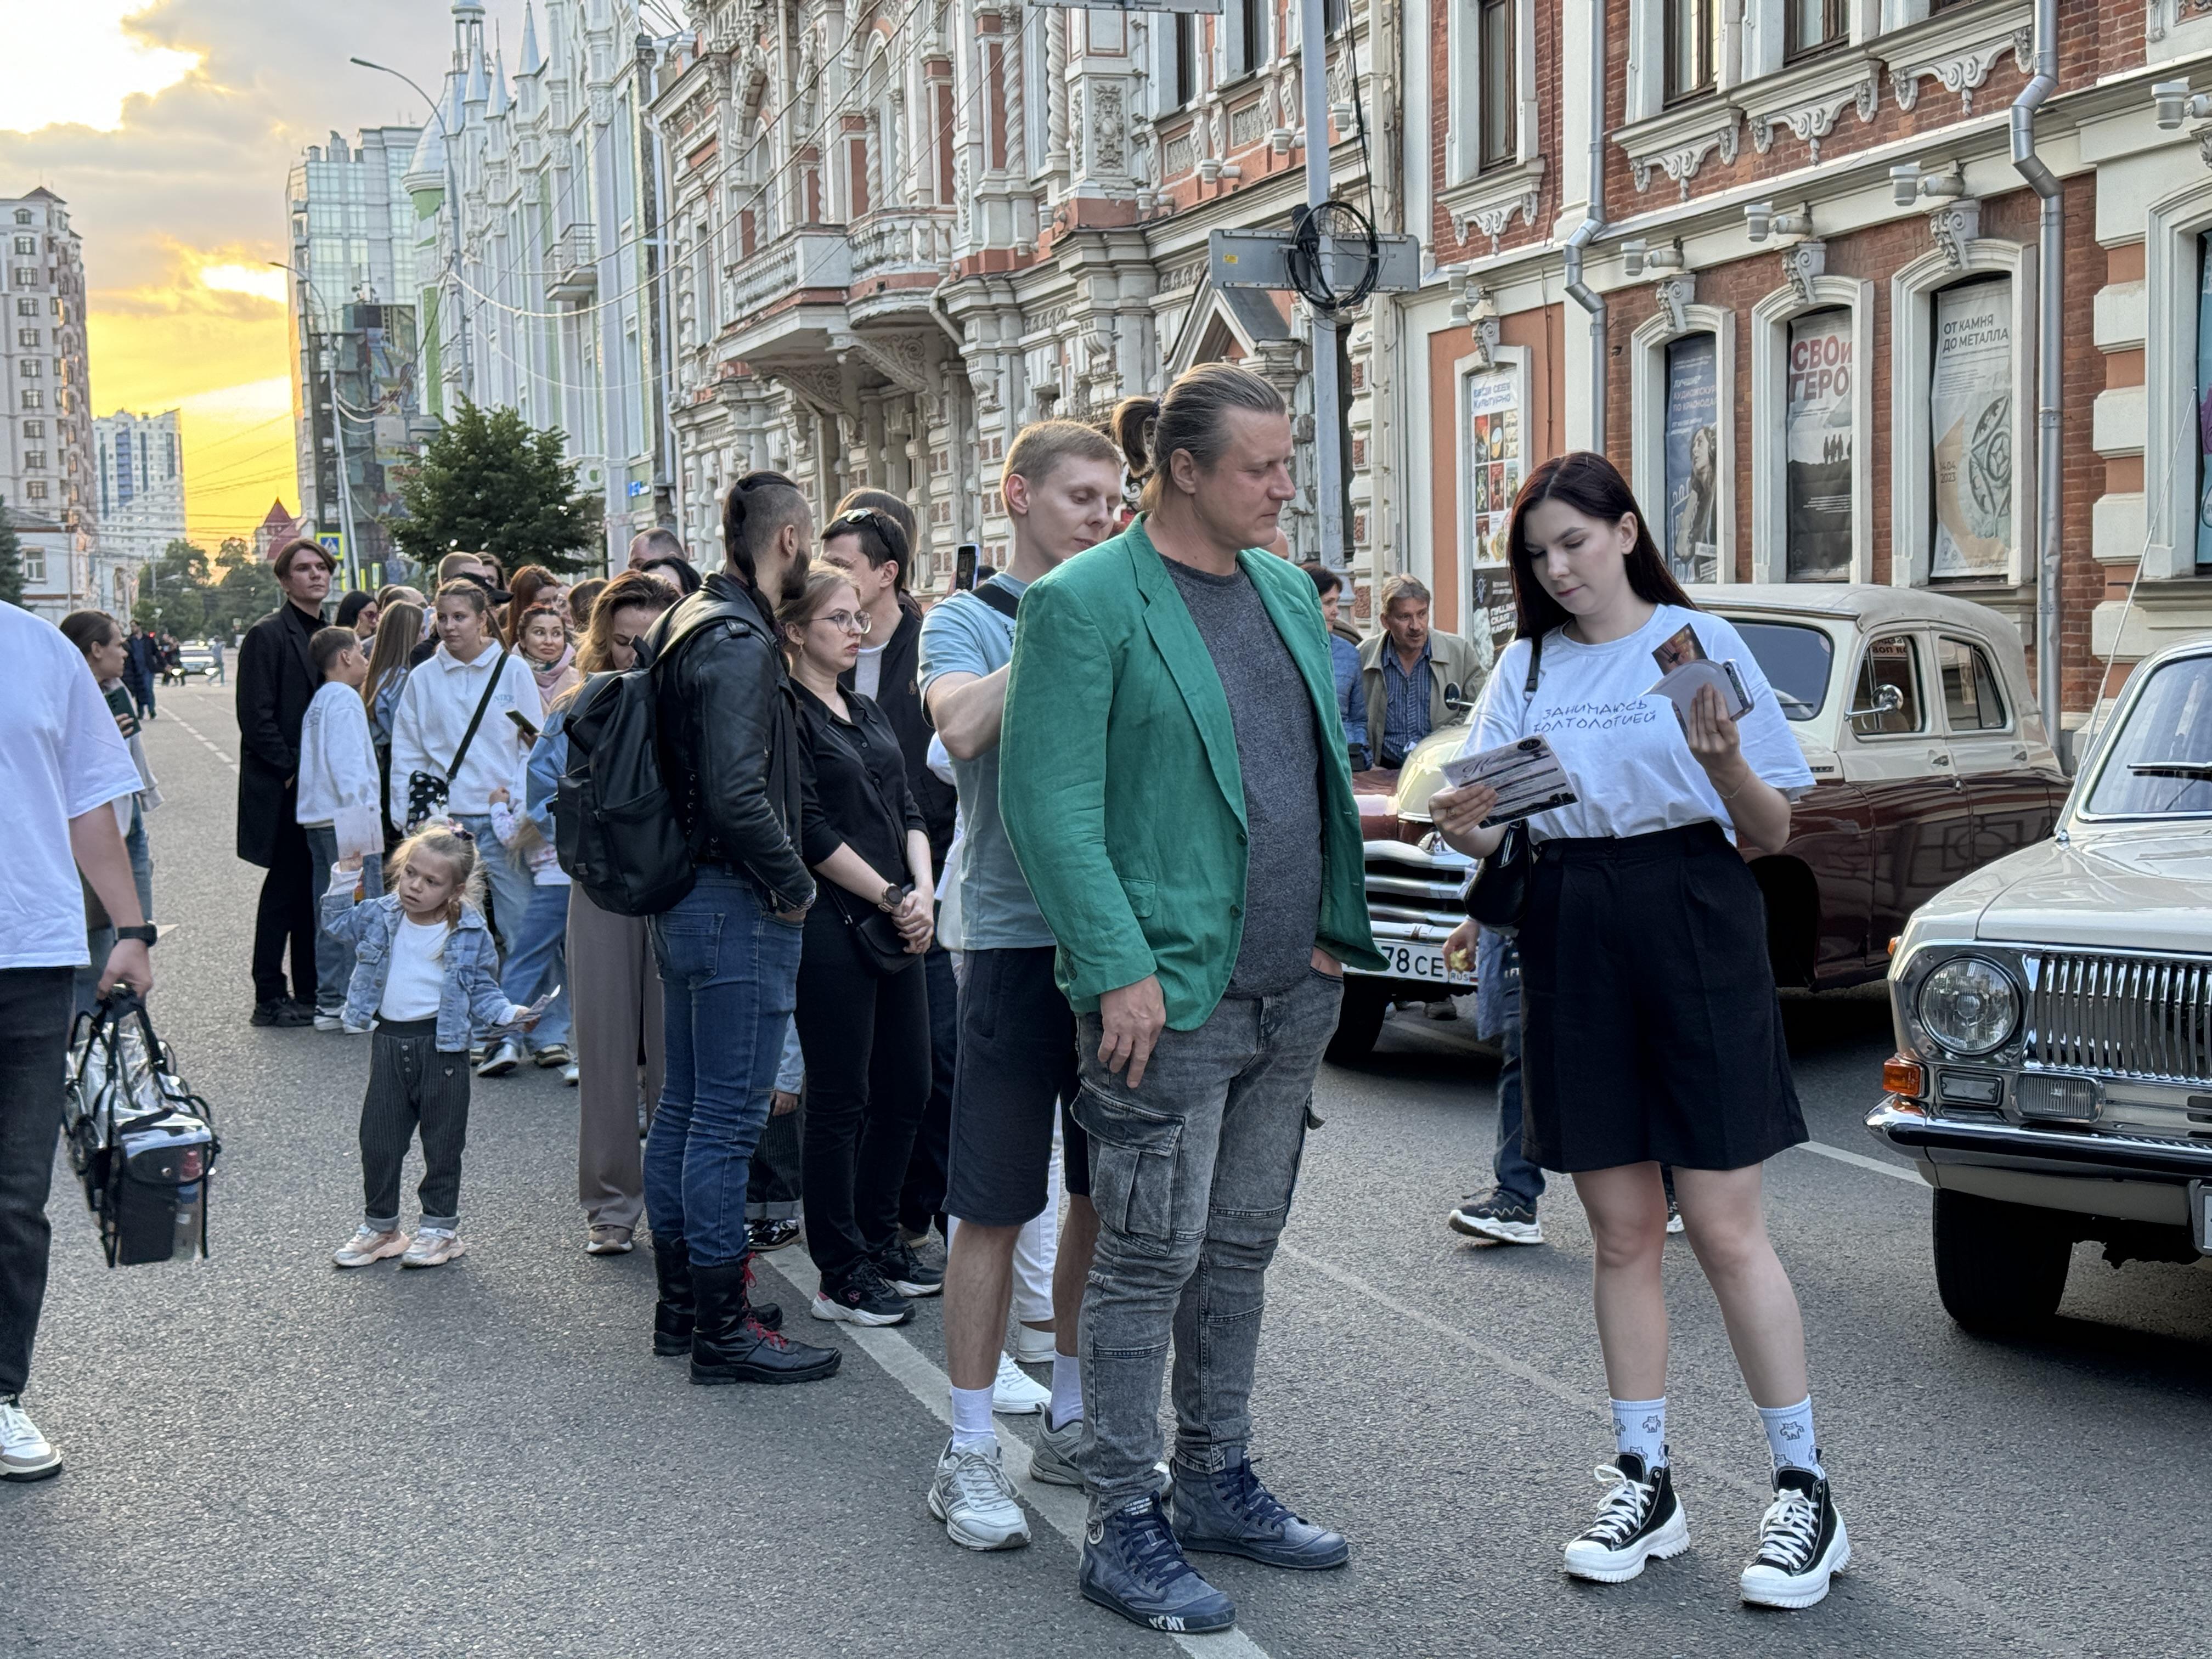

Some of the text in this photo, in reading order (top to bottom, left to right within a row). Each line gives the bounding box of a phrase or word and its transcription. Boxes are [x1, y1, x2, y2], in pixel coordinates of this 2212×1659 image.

[1944, 314, 1994, 335] ОТ КАМНЯ
[1943, 338, 1957, 353] ДО
[1959, 328, 2008, 347] МЕТАЛЛА
[1790, 365, 1849, 403] ГЕРО
[1940, 472, 1956, 483] 2023
[1543, 699, 1648, 720] ЗАНИМАЮСЬ
[1380, 945, 1444, 978] 78СЕ
[1450, 972, 1470, 981] RUS
